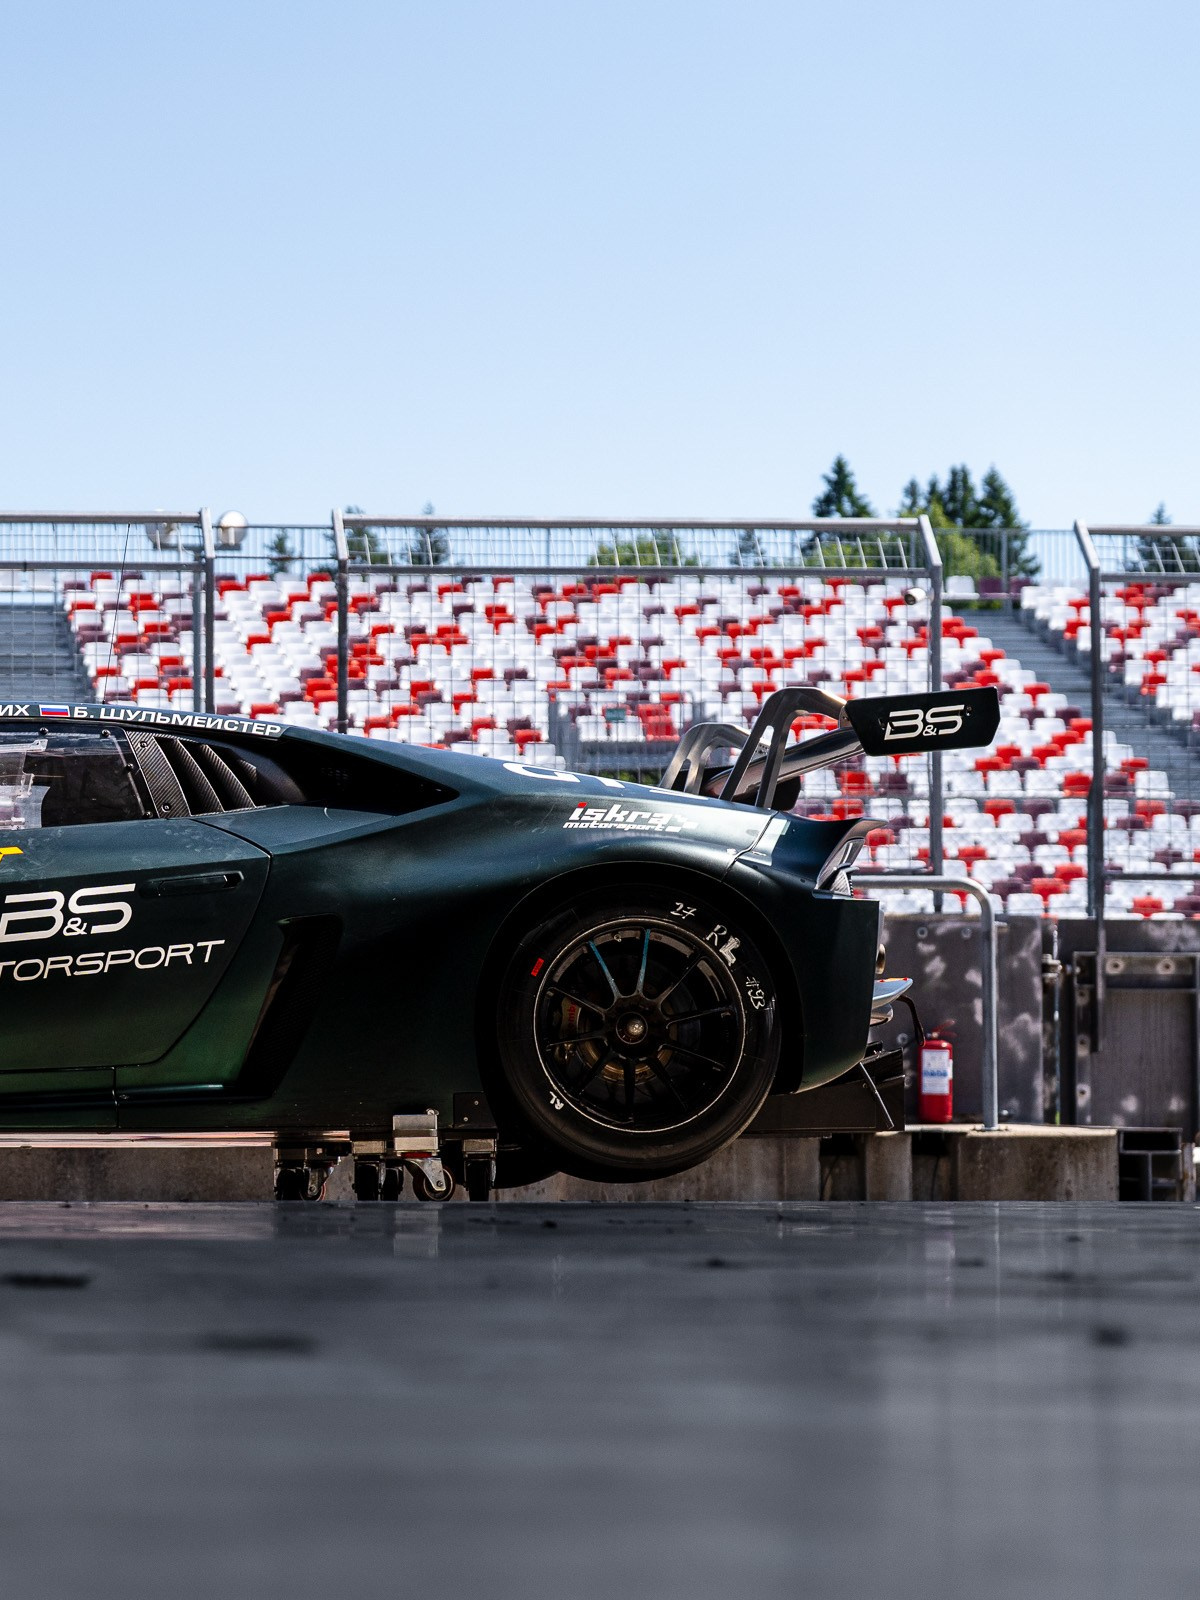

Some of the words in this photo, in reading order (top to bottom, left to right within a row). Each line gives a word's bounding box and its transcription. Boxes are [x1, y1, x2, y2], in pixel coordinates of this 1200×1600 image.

[73, 706, 94, 719] Б.
[884, 704, 965, 741] B&S
[563, 819, 664, 831] motorsport
[569, 802, 673, 825] iskra
[670, 902, 697, 920] 27
[706, 924, 741, 967] RL
